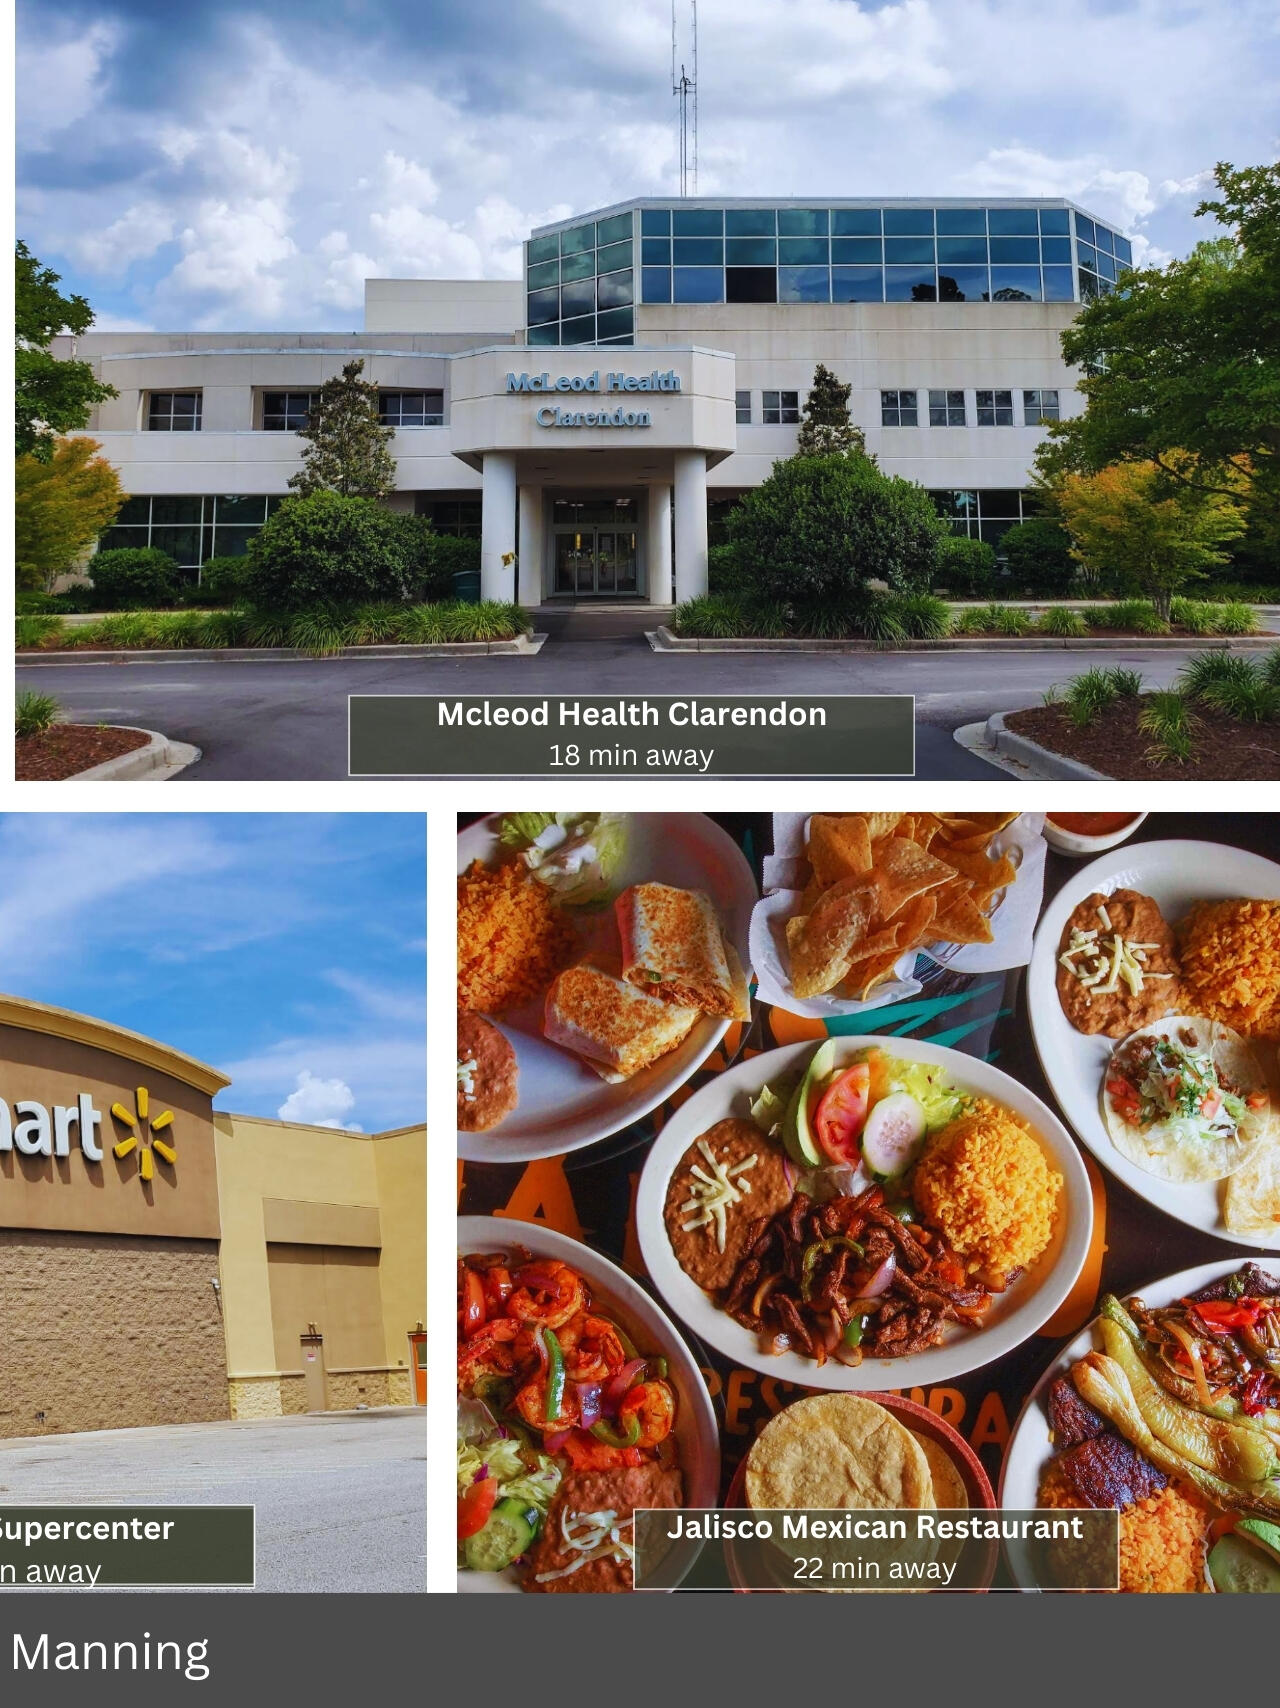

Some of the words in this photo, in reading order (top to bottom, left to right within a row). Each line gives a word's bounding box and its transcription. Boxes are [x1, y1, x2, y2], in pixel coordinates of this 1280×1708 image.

[505, 370, 601, 393] McLeod
[606, 370, 682, 393] Health
[536, 407, 652, 428] Clarendon
